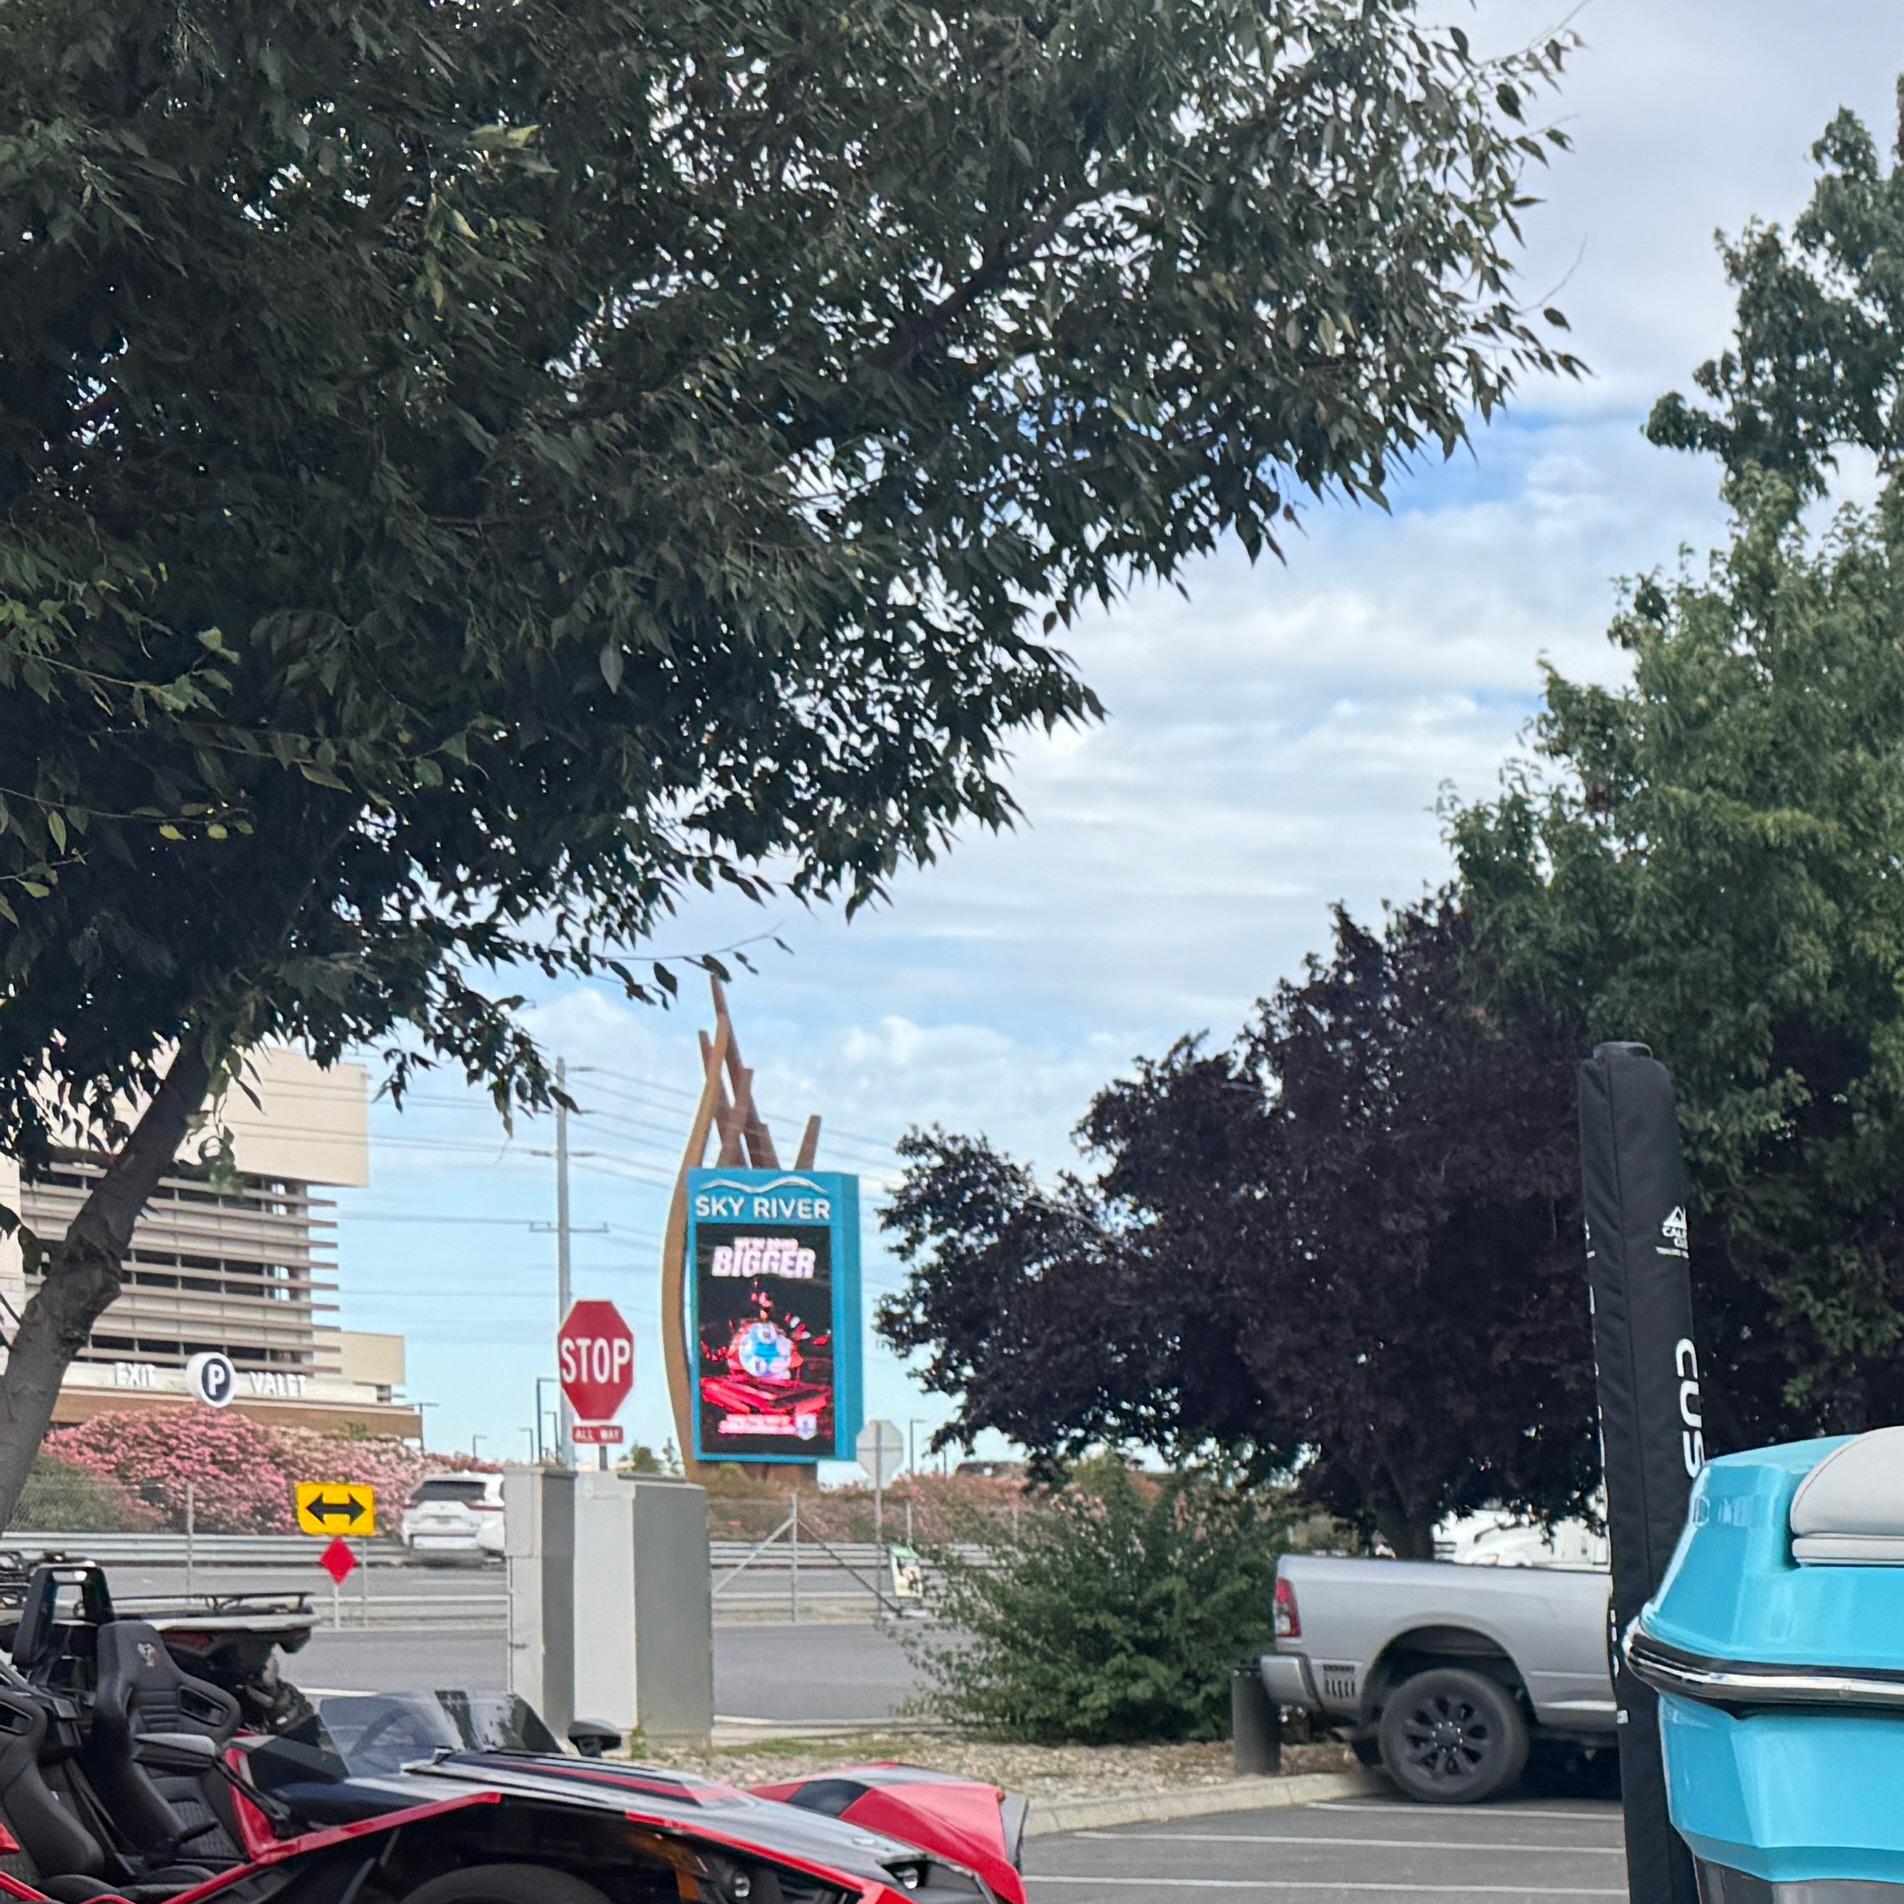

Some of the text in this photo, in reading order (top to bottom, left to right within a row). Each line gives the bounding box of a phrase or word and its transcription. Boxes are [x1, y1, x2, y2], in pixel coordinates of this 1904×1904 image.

[695, 1195, 831, 1220] SKY RIVER
[711, 1245, 816, 1279] BIGGER
[560, 1337, 631, 1384] STOP
[114, 1362, 156, 1386] EXIT
[208, 1363, 226, 1396] P
[250, 1371, 307, 1397] VALET
[575, 1428, 620, 1440] ALL WAY
